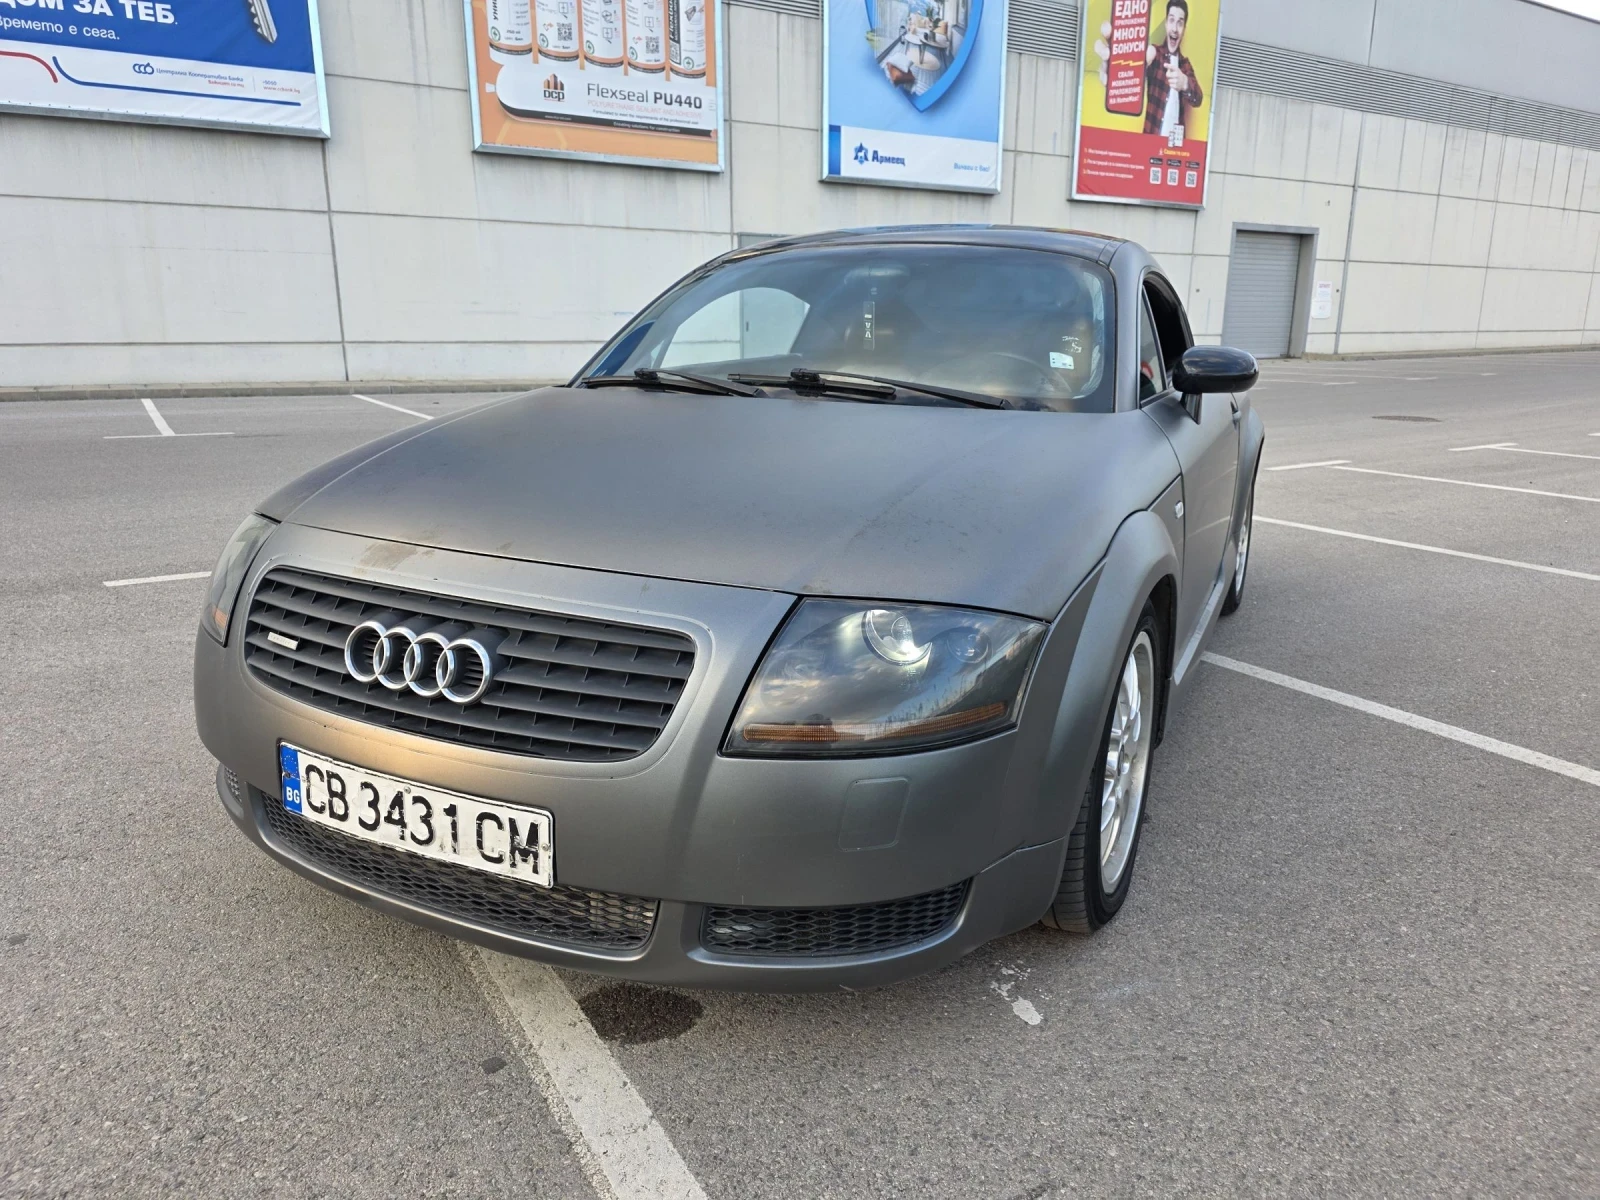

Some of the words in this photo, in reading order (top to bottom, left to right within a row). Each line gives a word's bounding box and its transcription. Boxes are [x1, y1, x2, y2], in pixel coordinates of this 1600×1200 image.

[1115, 0, 1148, 18] ЕДНО
[69, 25, 78, 35] е
[83, 26, 120, 40] сега.
[1114, 26, 1146, 41] МНОГО
[1112, 41, 1145, 54] БОНУСИ
[587, 83, 649, 103] Flexseal
[653, 91, 703, 109] PU440
[871, 150, 906, 166] Армеец
[285, 786, 300, 804] BG
[305, 763, 350, 823] CB
[358, 781, 461, 855] 3431
[476, 811, 540, 875] CM
